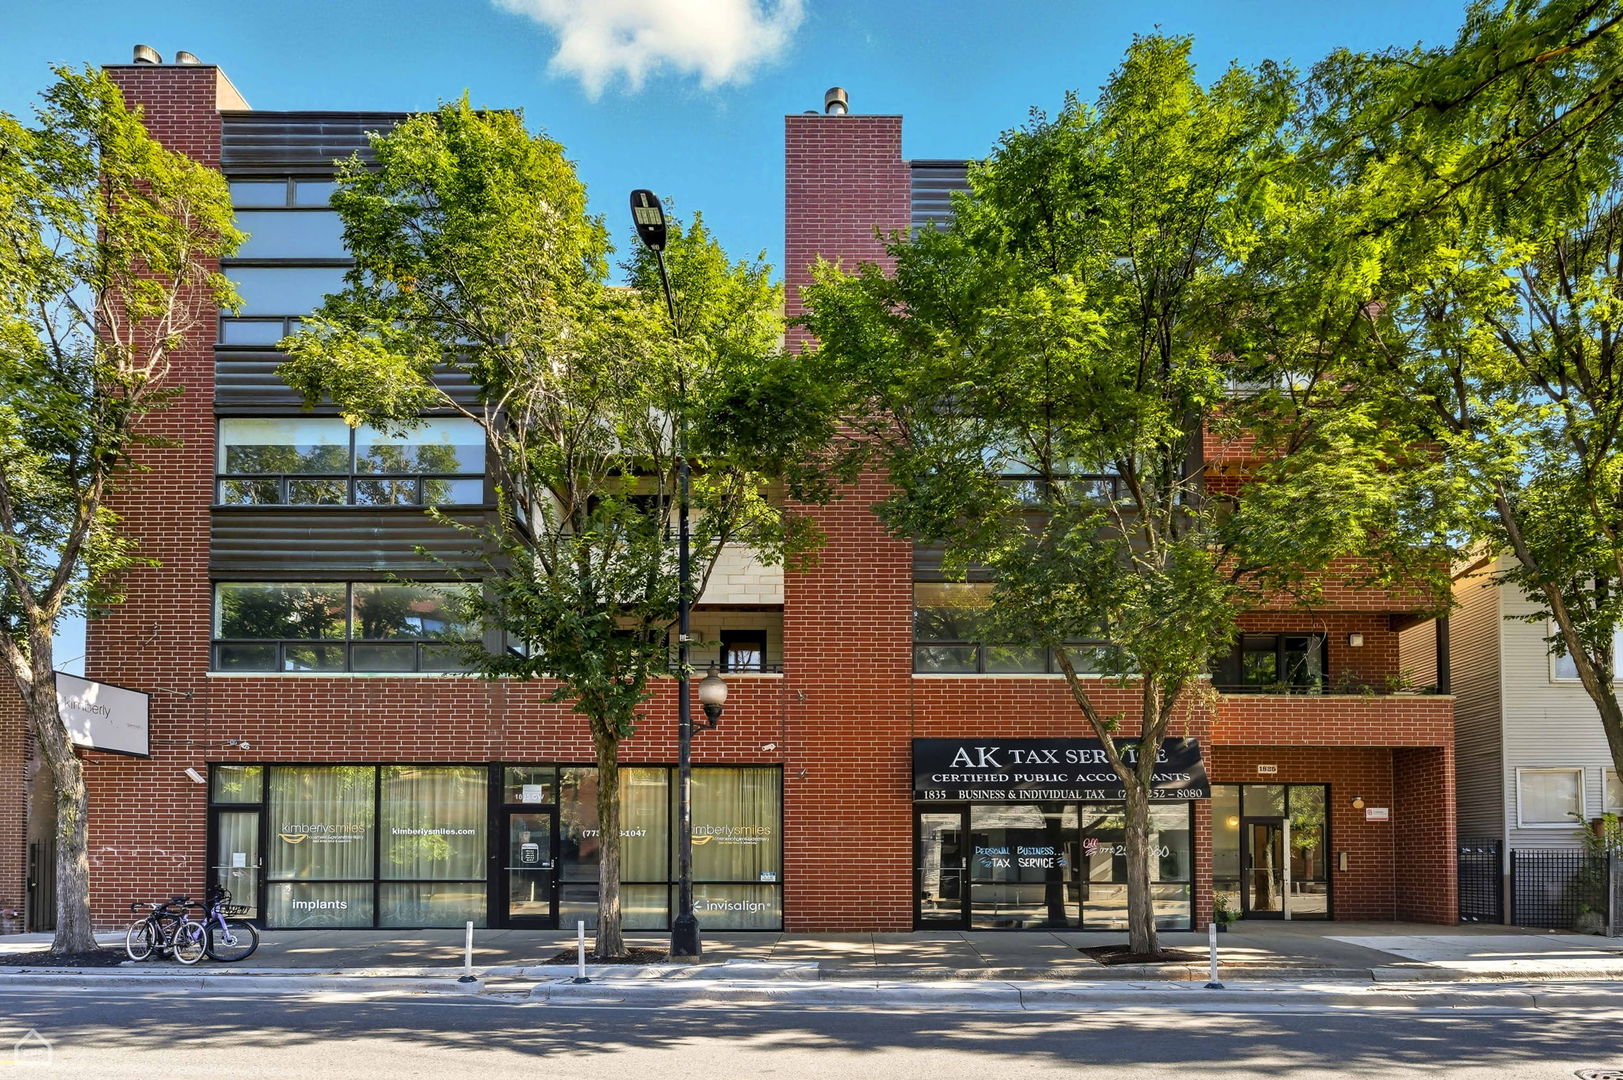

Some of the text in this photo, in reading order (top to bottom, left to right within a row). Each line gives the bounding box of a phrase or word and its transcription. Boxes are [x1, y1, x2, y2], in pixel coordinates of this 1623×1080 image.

[949, 746, 1169, 768] AK TAX SERIE
[932, 773, 1191, 782] CERTIFIED PUBLIC ACCOANTS
[923, 790, 947, 799] 1835
[959, 789, 1005, 799] BUSINESS
[1007, 790, 1016, 799] &
[1019, 789, 1082, 799] INDIVIDUAL
[1084, 789, 1105, 799] TAX
[1176, 788, 1203, 798] 8080
[282, 822, 365, 834] kimberlysmiles
[392, 827, 476, 836] kimberlysmiles.com
[691, 824, 771, 837] imberlysmiles
[991, 858, 1055, 868] TAX SERVICE
[292, 899, 348, 911] implants
[706, 900, 766, 913] invisalign
